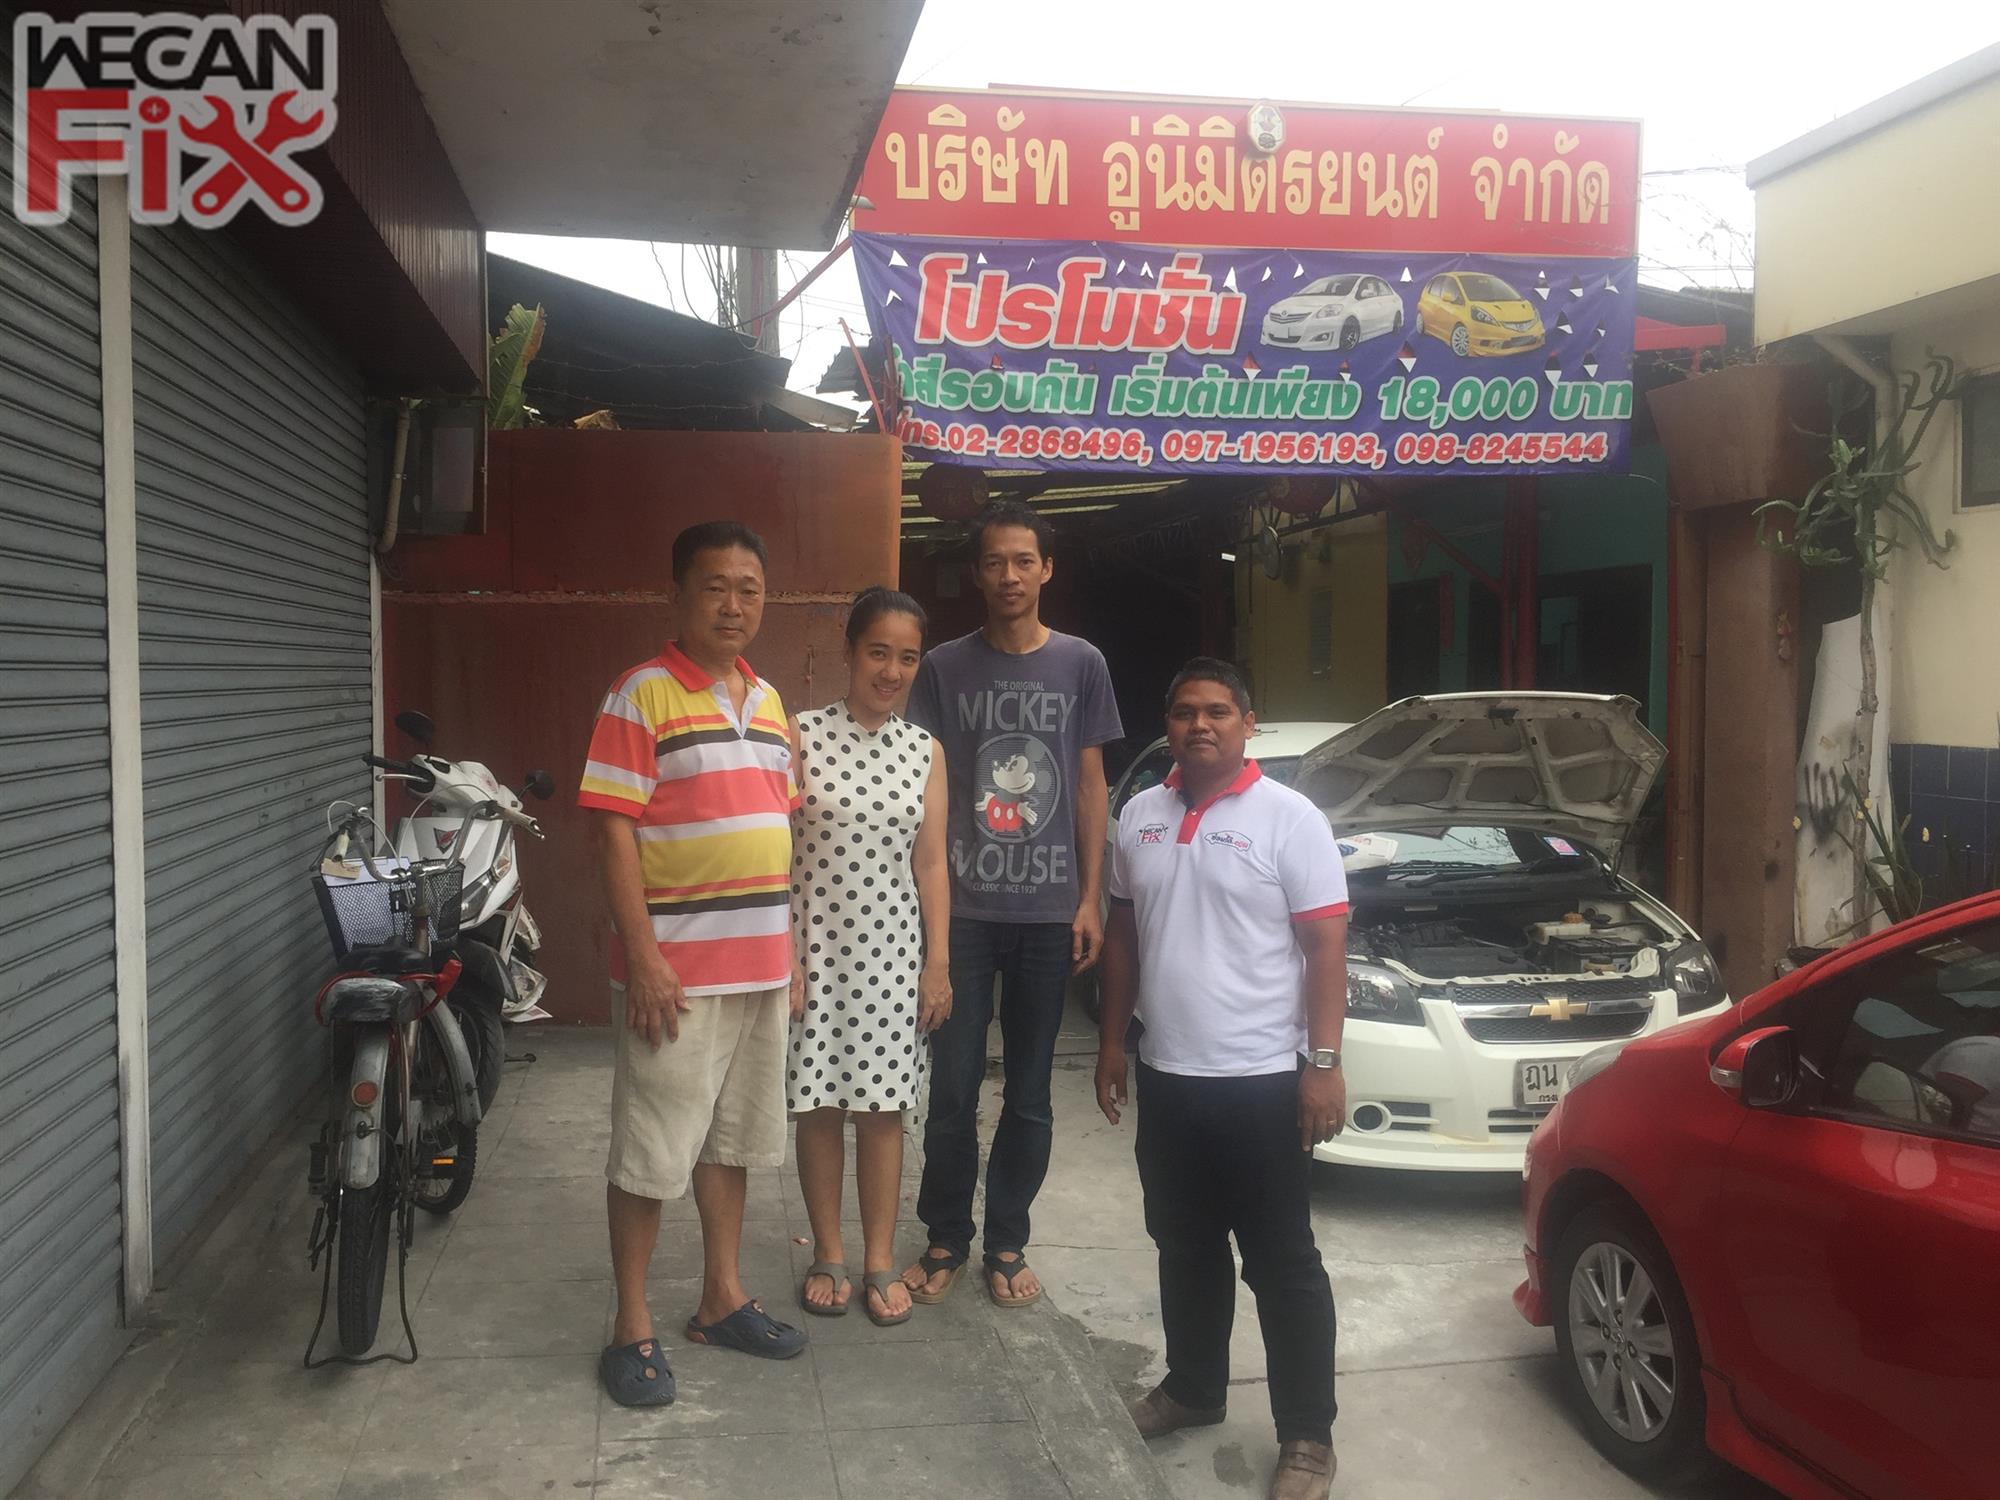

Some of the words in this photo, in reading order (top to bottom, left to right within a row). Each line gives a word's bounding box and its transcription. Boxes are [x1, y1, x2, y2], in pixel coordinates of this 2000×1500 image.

[884, 103, 1069, 206] บริษัท
[1102, 114, 1444, 231] อู่นิมิตรยนต์
[1469, 122, 1611, 224] จำกัด
[914, 252, 1246, 355] โปรโมชั่น
[1107, 353, 1362, 420] เริ่มต้นเพียง
[1378, 375, 1539, 429] 18,000
[1549, 379, 1633, 420] บาท
[1161, 428, 1388, 469] 097-1956193,
[1394, 430, 1609, 466] 098-8245544
[993, 680, 1008, 691] THE
[1009, 680, 1045, 692] ORIGINAL
[957, 690, 1078, 733] MICKEY
[951, 839, 1068, 884] MOUSE
